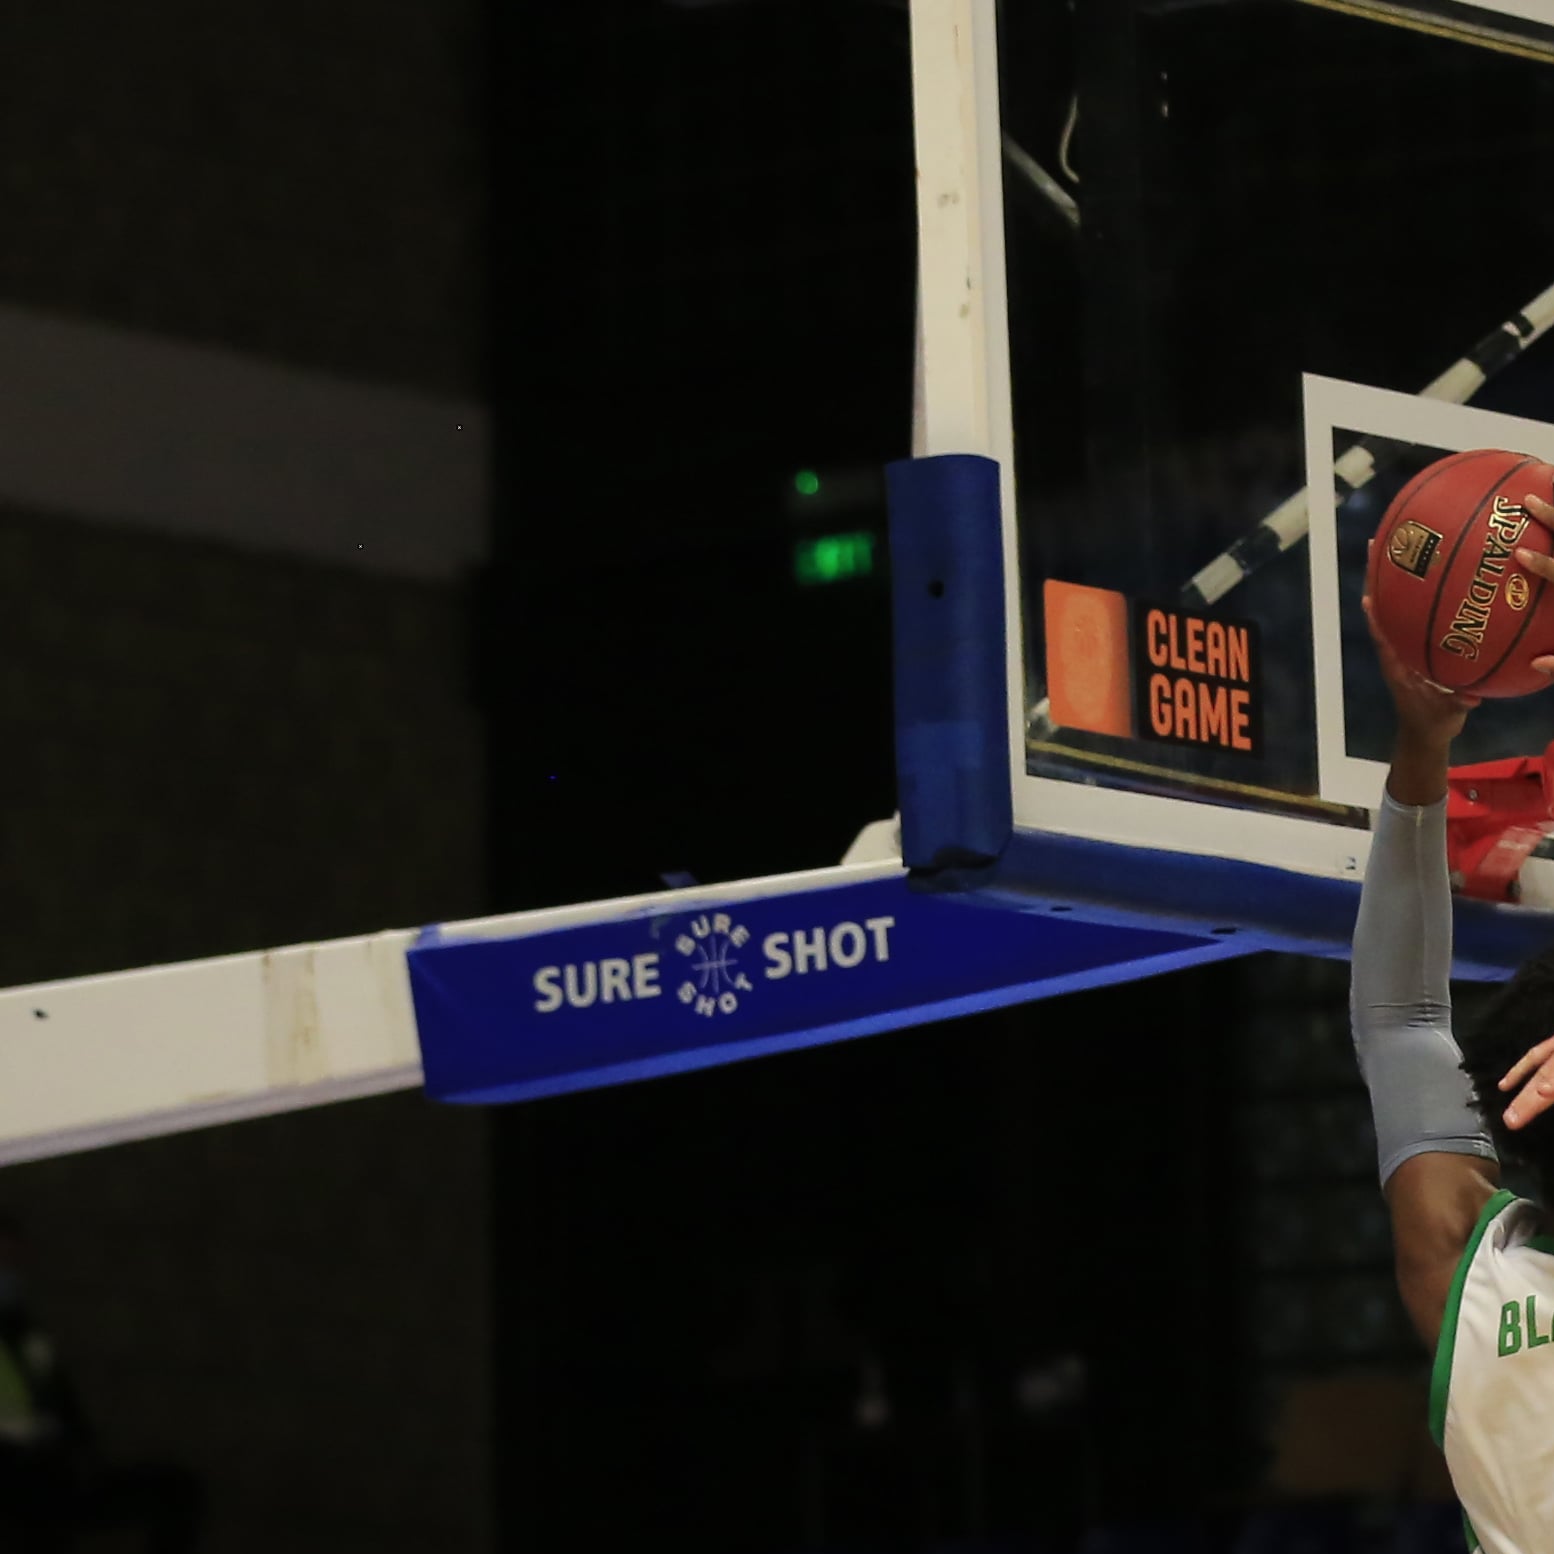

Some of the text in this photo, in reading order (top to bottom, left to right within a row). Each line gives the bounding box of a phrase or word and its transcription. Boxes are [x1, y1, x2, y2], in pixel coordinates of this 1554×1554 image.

[1440, 495, 1530, 662] SPALDING
[1147, 608, 1250, 683] CLEAN
[1150, 672, 1253, 751] GAME
[533, 915, 896, 1013] SURE SHOT
[675, 912, 751, 956] SURE
[676, 971, 753, 1018] SHOT
